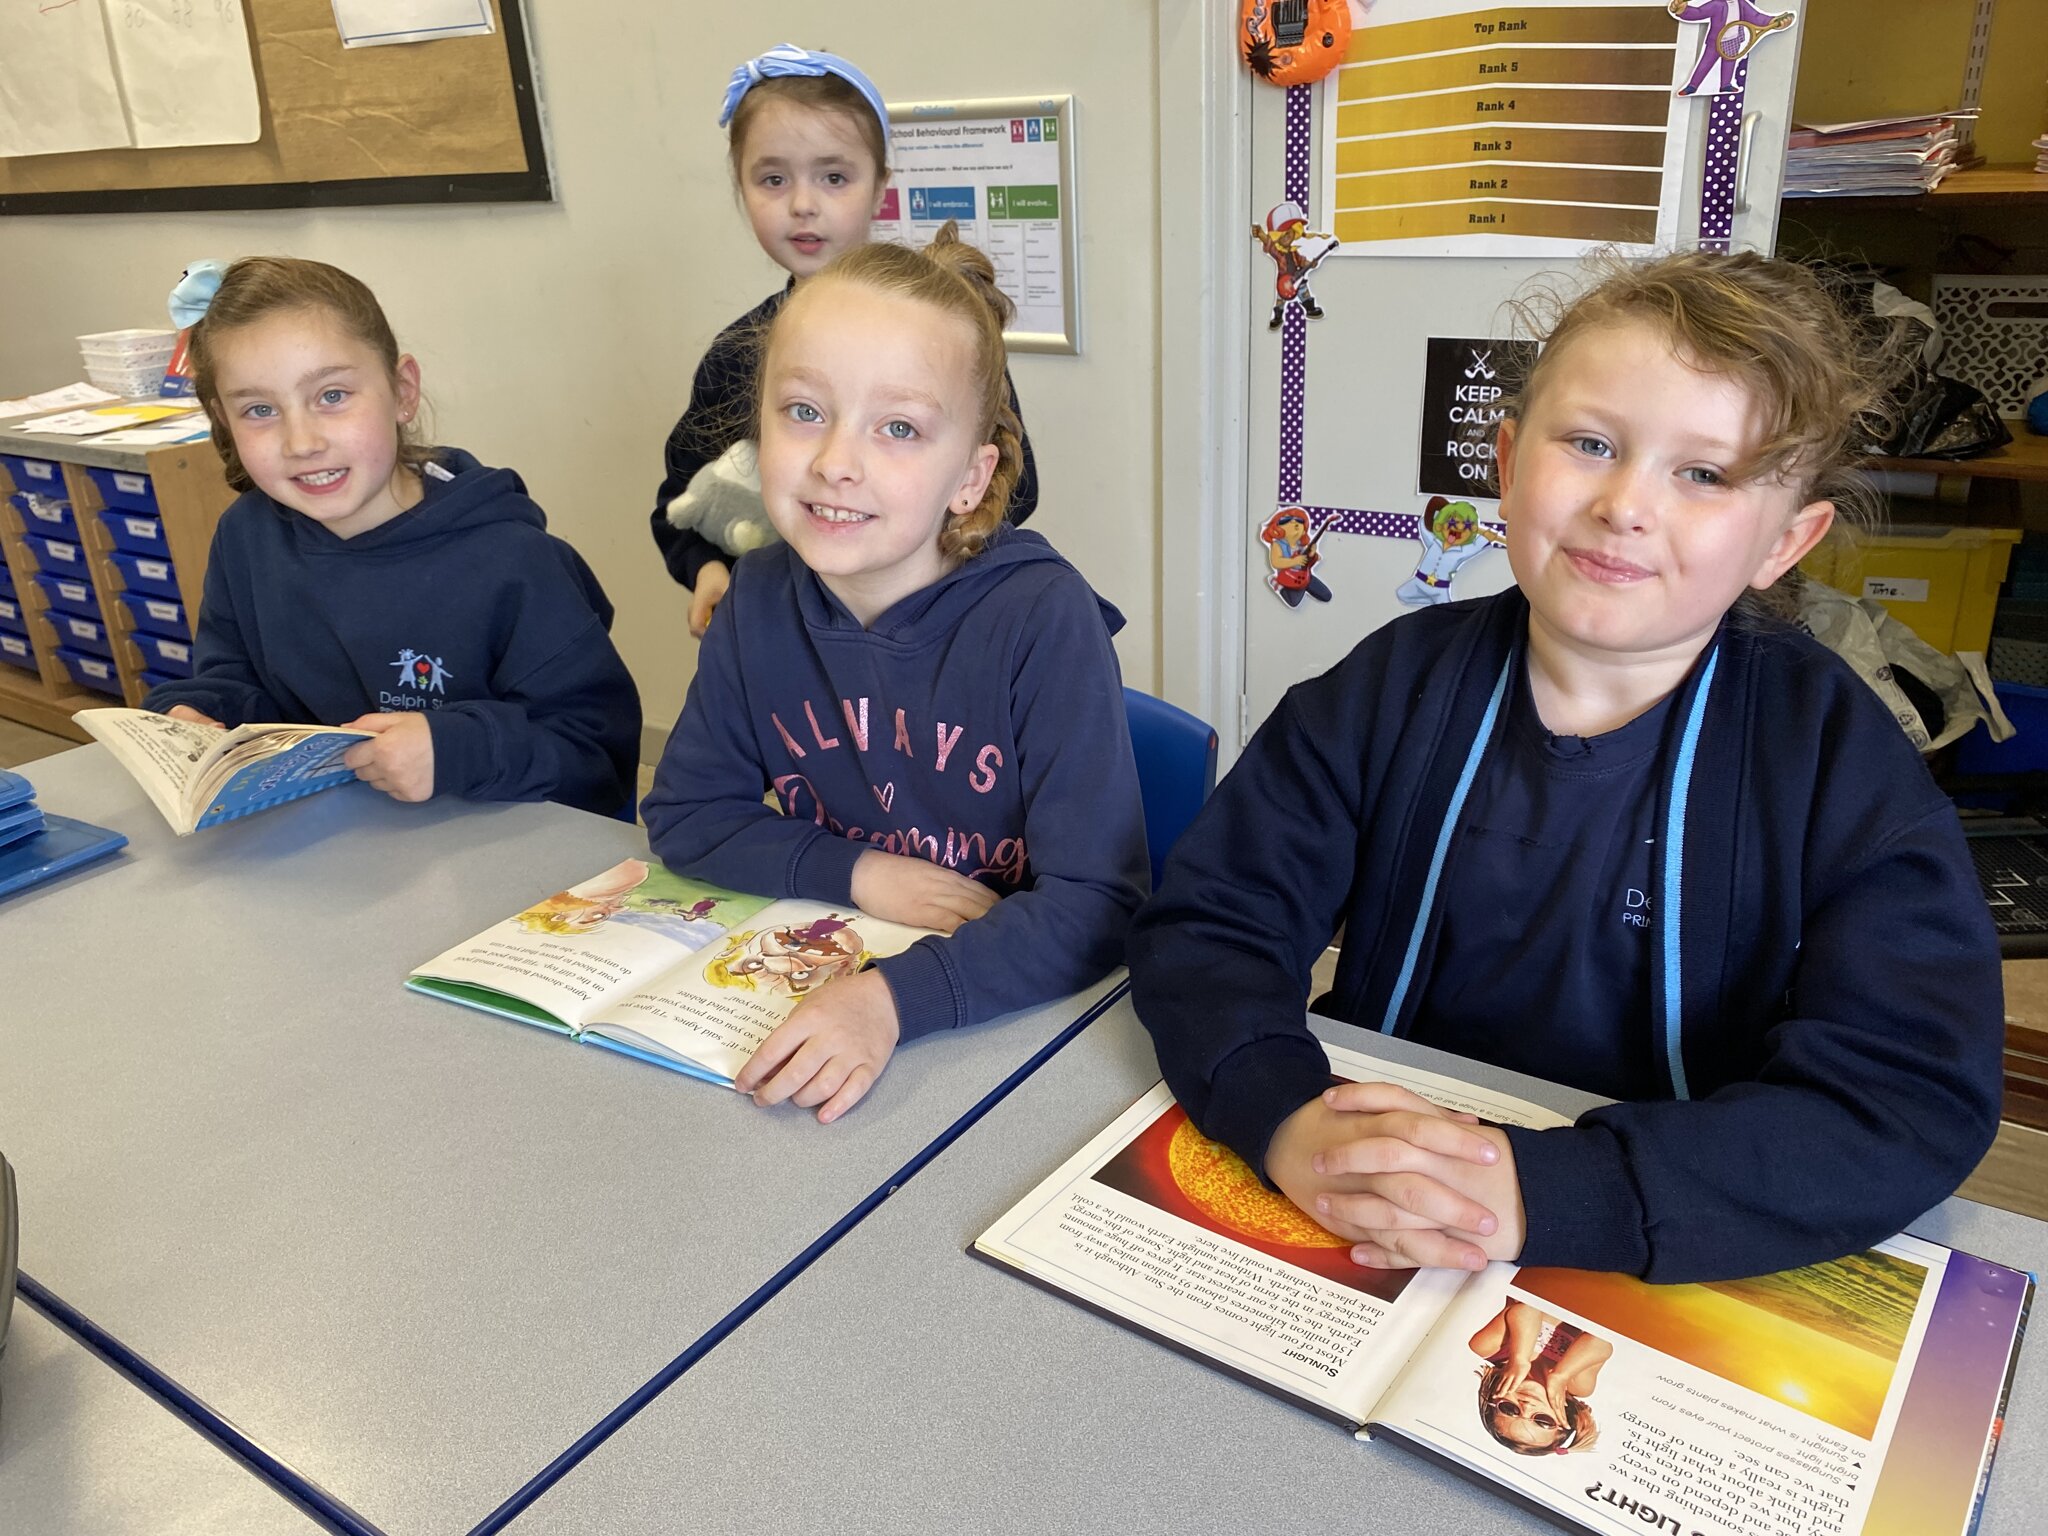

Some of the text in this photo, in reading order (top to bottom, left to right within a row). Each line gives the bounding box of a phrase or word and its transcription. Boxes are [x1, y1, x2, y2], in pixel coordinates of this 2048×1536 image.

[1474, 20, 1528, 34] Top Rank
[1479, 62, 1519, 73] Rank 5
[1476, 100, 1516, 111] Rank 4
[916, 126, 961, 138] Behavioural
[962, 124, 1007, 136] Framework
[1473, 141, 1512, 151] Rank 3
[1469, 179, 1508, 189] Rank 2
[1469, 214, 1505, 223] Rank 1
[1449, 407, 1506, 424] CALM
[1455, 385, 1502, 403] KEEP
[1447, 441, 1498, 460] ROCK
[1467, 429, 1486, 438] AND
[1459, 463, 1488, 480] ON
[380, 691, 426, 709] Delph
[1064, 1212, 1362, 1347] Earth, the Sun our nearest star. gives off huge amounts
[1069, 1203, 1355, 1328] energy the form heat and light. Some this energy
[1071, 1192, 1377, 1326] reaches Earth. Without sunlight Earth would cold,
[1194, 1236, 1384, 1317] dark place. Nothing would live here.
[1058, 1222, 1353, 1356] 150 million kilometres (about 93 million miles) away from
[1093, 1251, 1347, 1367] Most our light comes from the Sun. Although
[1650, 1395, 1841, 1484] Sunglasses protect your eyes from
[1655, 1375, 1848, 1462] Sunlight what makes plants grow
[1796, 1448, 1859, 1481] bright light.
[1817, 1434, 1848, 1452] Earth.
[1618, 1410, 1844, 1522] Light really form energy
[1621, 1440, 1800, 1533] but we not often stop
[1627, 1428, 1841, 1532] and think about what light is.
[1733, 1449, 1849, 1508] that we can see.
[1584, 1480, 1681, 1536] LIGHT?
[1608, 1463, 1744, 1533] something that we
[1618, 1452, 1771, 1530] and depend every
